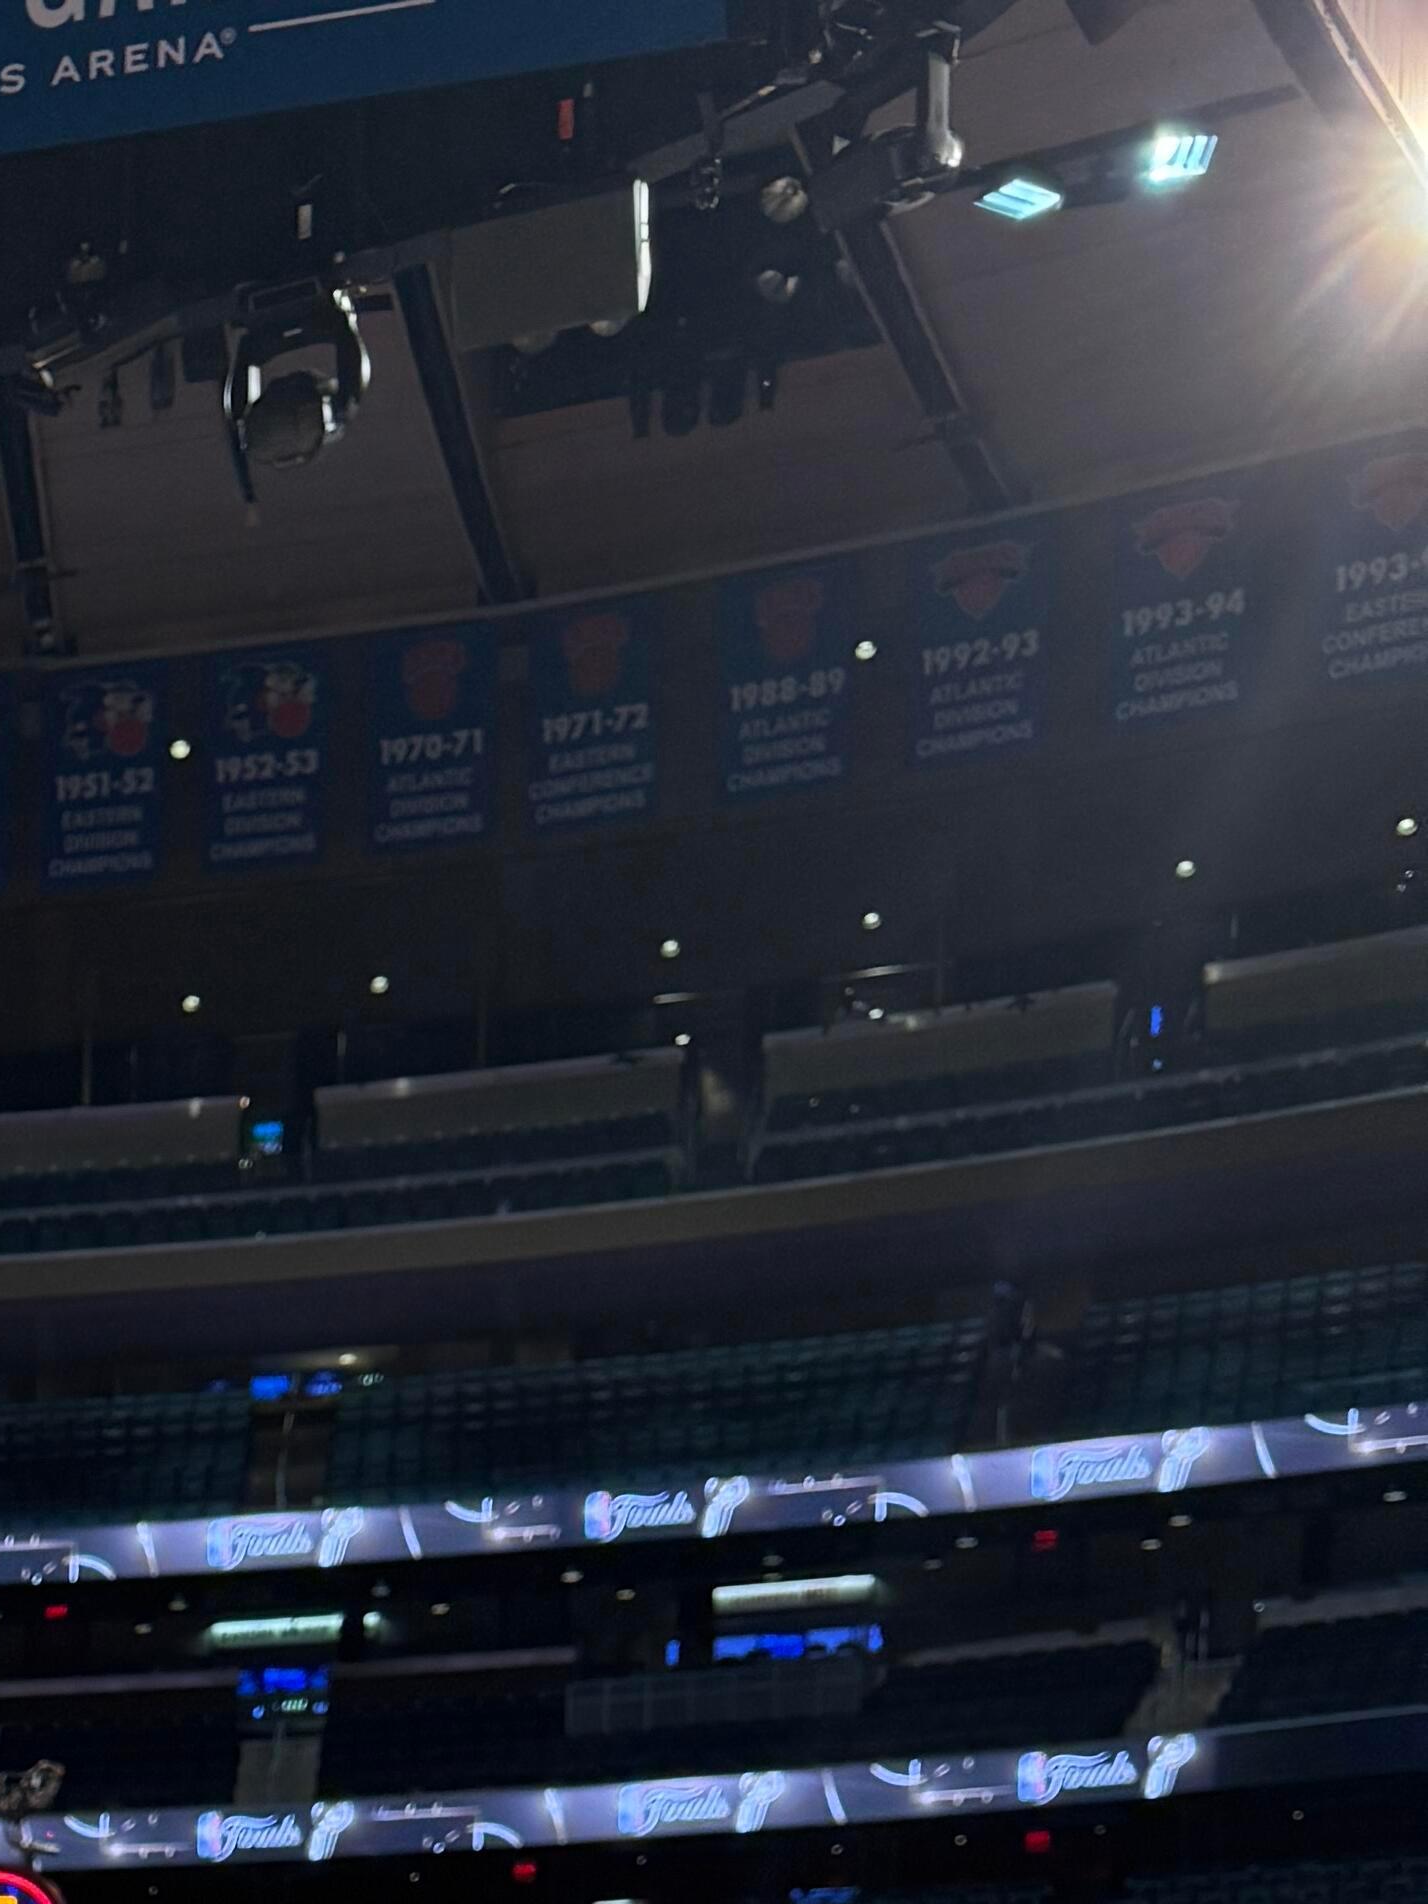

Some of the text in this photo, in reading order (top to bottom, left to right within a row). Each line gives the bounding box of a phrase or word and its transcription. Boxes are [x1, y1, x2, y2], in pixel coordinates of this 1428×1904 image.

[1121, 587, 1246, 638] 1993-94
[921, 628, 1040, 677] 1992-93
[729, 666, 845, 713] 1988-89
[378, 727, 487, 766] 1970-71
[543, 703, 650, 746] 1971-72
[214, 749, 322, 784] 1952-53
[1049, 1444, 1153, 1500] Finals
[605, 1490, 695, 1544] Finals
[227, 1520, 312, 1570] Finals
[1040, 1751, 1139, 1806] Finals
[634, 1784, 731, 1836] Finals
[213, 1813, 303, 1863] Finals
